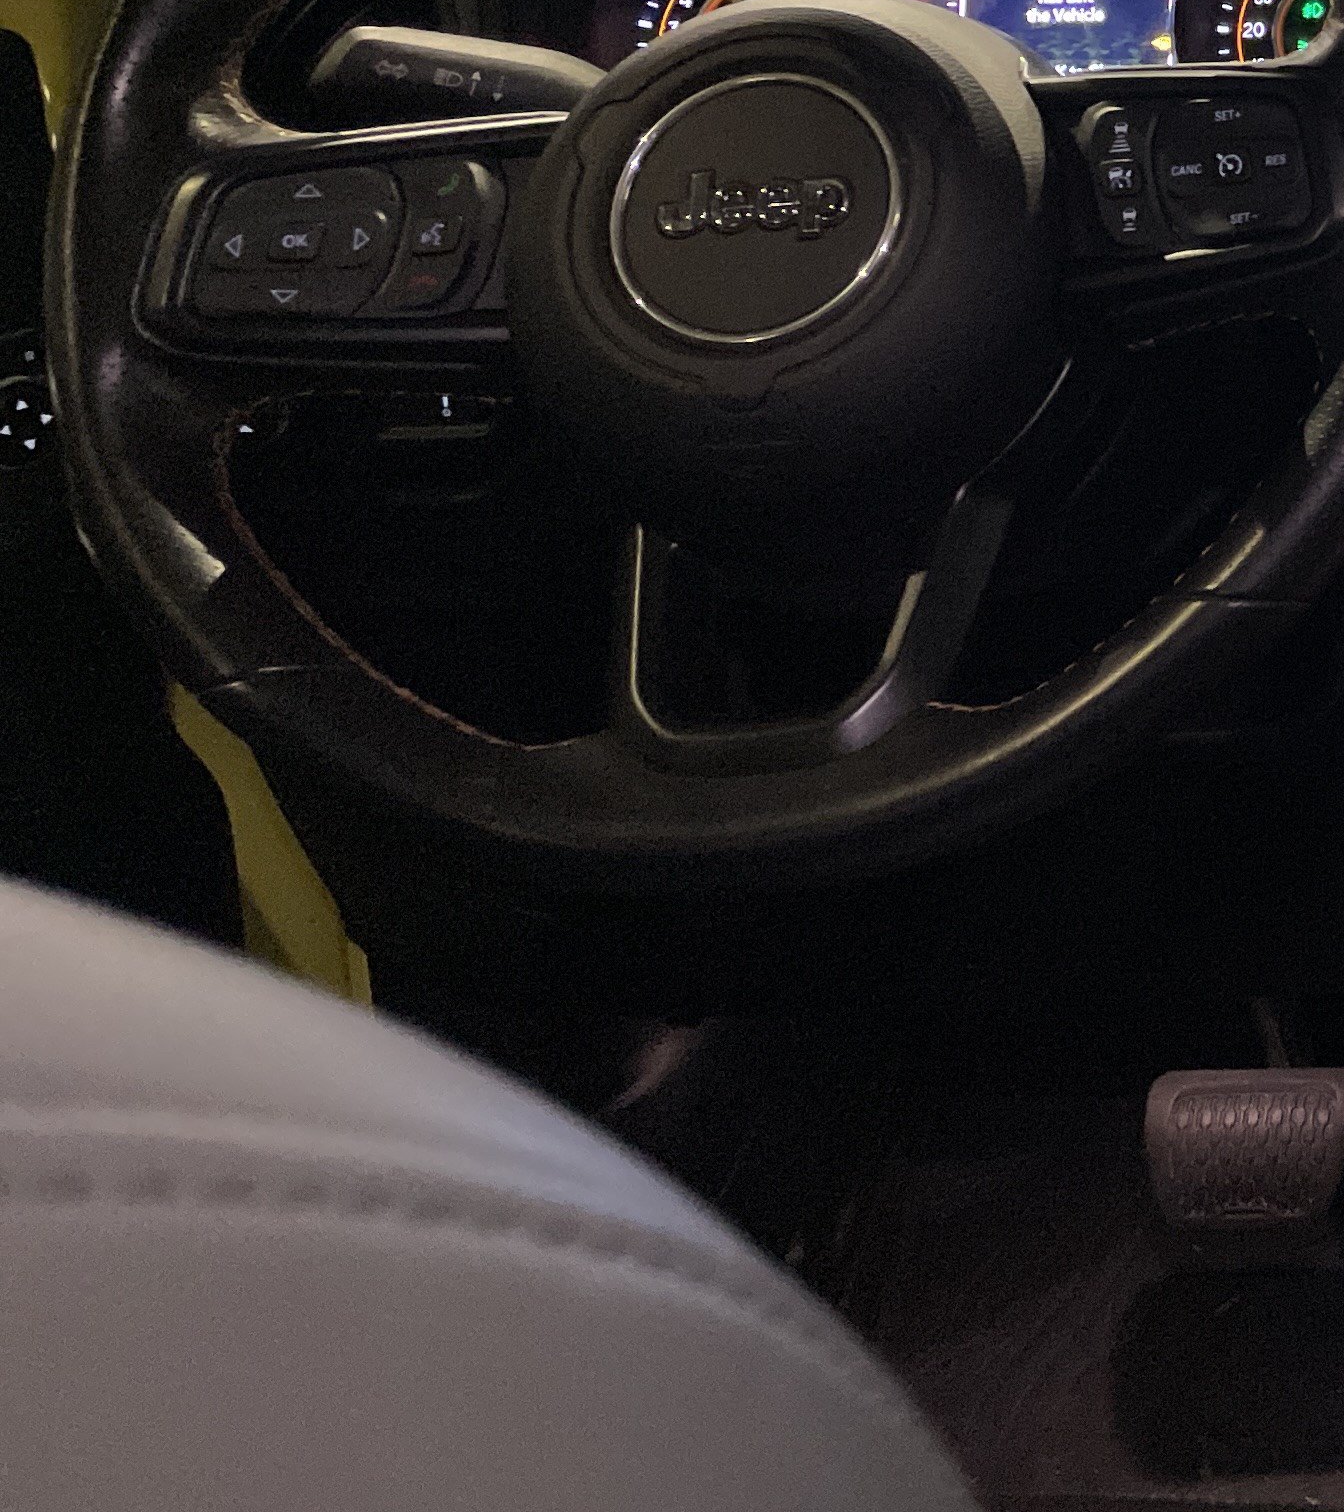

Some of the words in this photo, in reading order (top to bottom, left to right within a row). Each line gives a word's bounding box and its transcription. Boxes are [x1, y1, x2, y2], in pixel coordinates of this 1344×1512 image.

[1025, 7, 1051, 24] the
[1052, 7, 1106, 25] Vehicle
[1241, 21, 1266, 39] 20
[1214, 108, 1242, 122] SET+
[1265, 153, 1287, 167] RES
[1171, 163, 1202, 177] CANC
[656, 168, 851, 242] Jeep
[281, 233, 309, 250] OK
